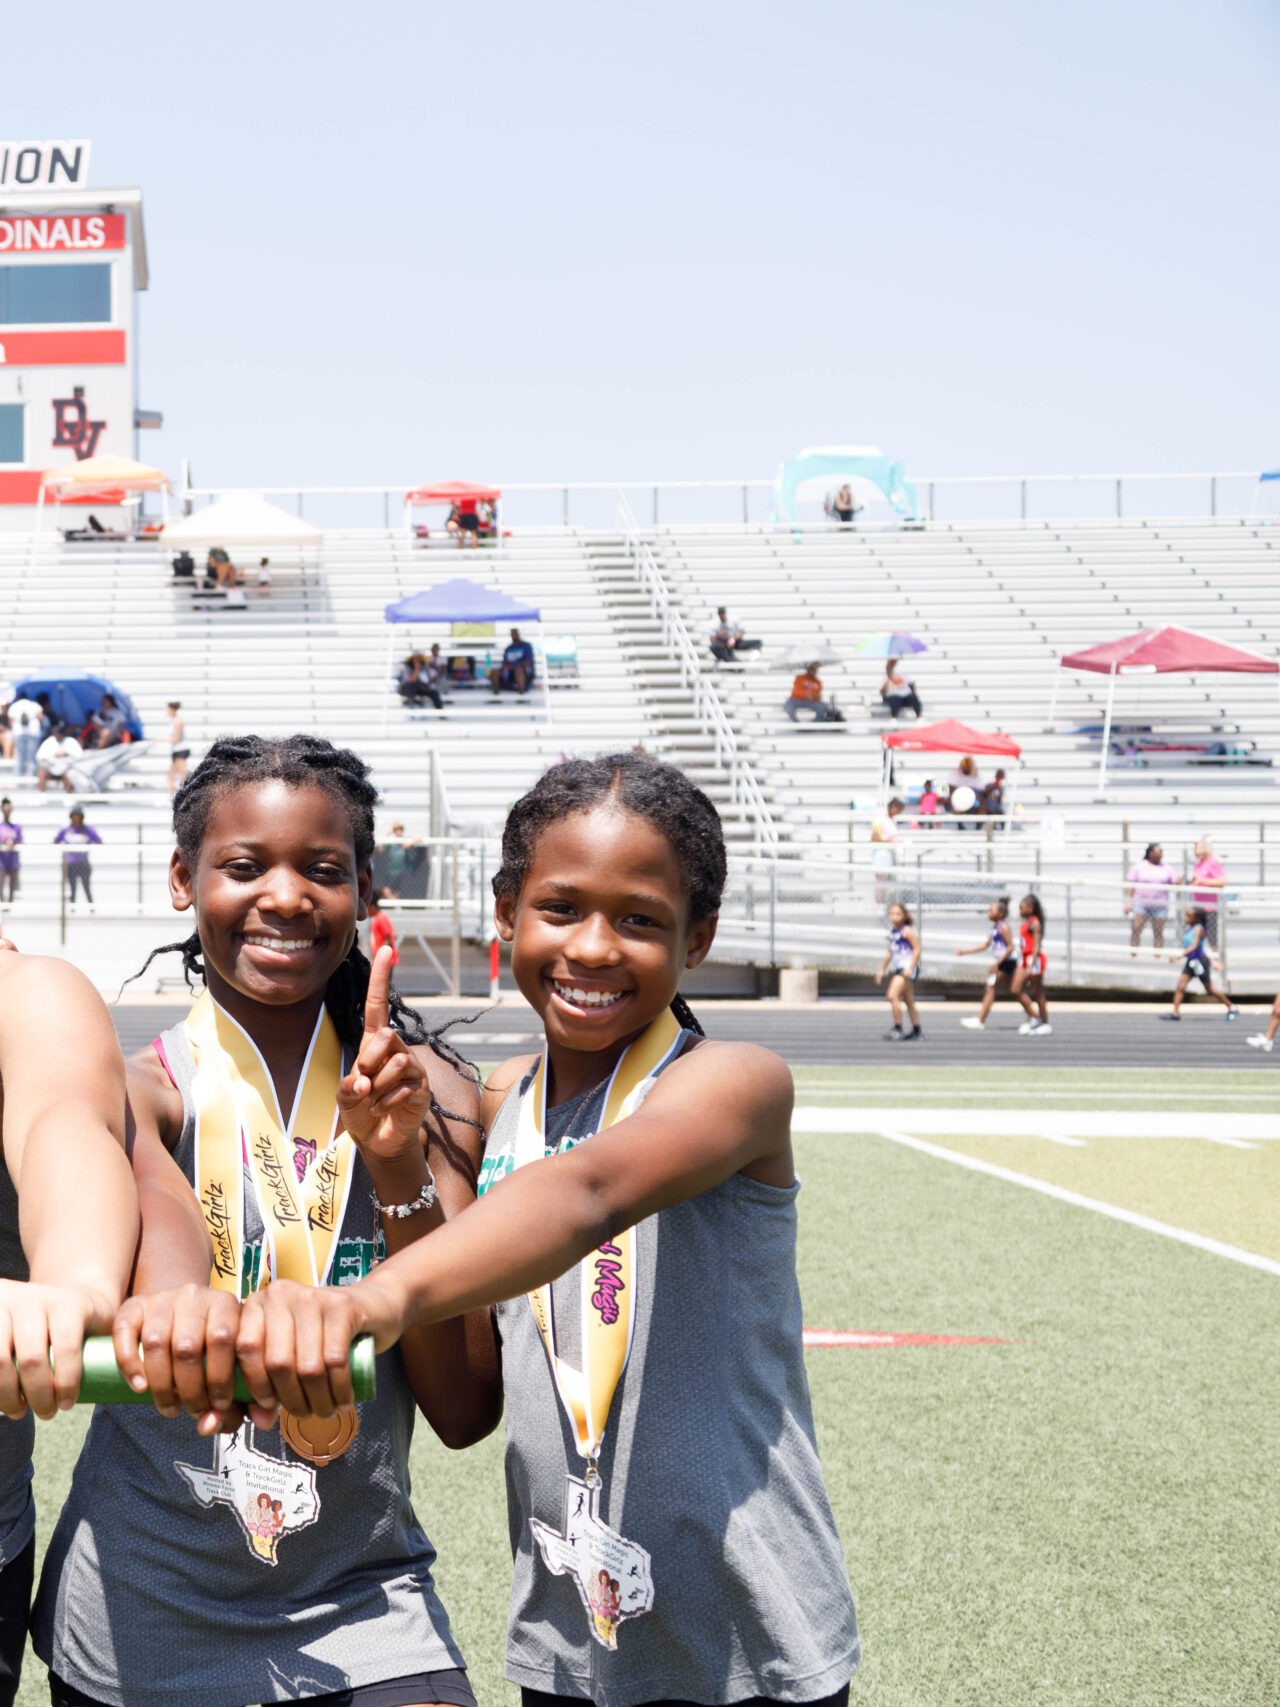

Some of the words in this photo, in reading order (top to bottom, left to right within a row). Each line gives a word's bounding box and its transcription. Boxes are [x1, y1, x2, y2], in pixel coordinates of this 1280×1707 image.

[254, 1134, 302, 1228] TrackGirlz
[201, 1182, 237, 1279] TrackGirlz
[591, 1259, 625, 1325] Magic
[239, 1460, 257, 1469] Track
[258, 1464, 271, 1473] Girl
[272, 1468, 293, 1478] Magic
[246, 1480, 285, 1494] Invitational
[253, 1472, 287, 1486] TrackGirlz
